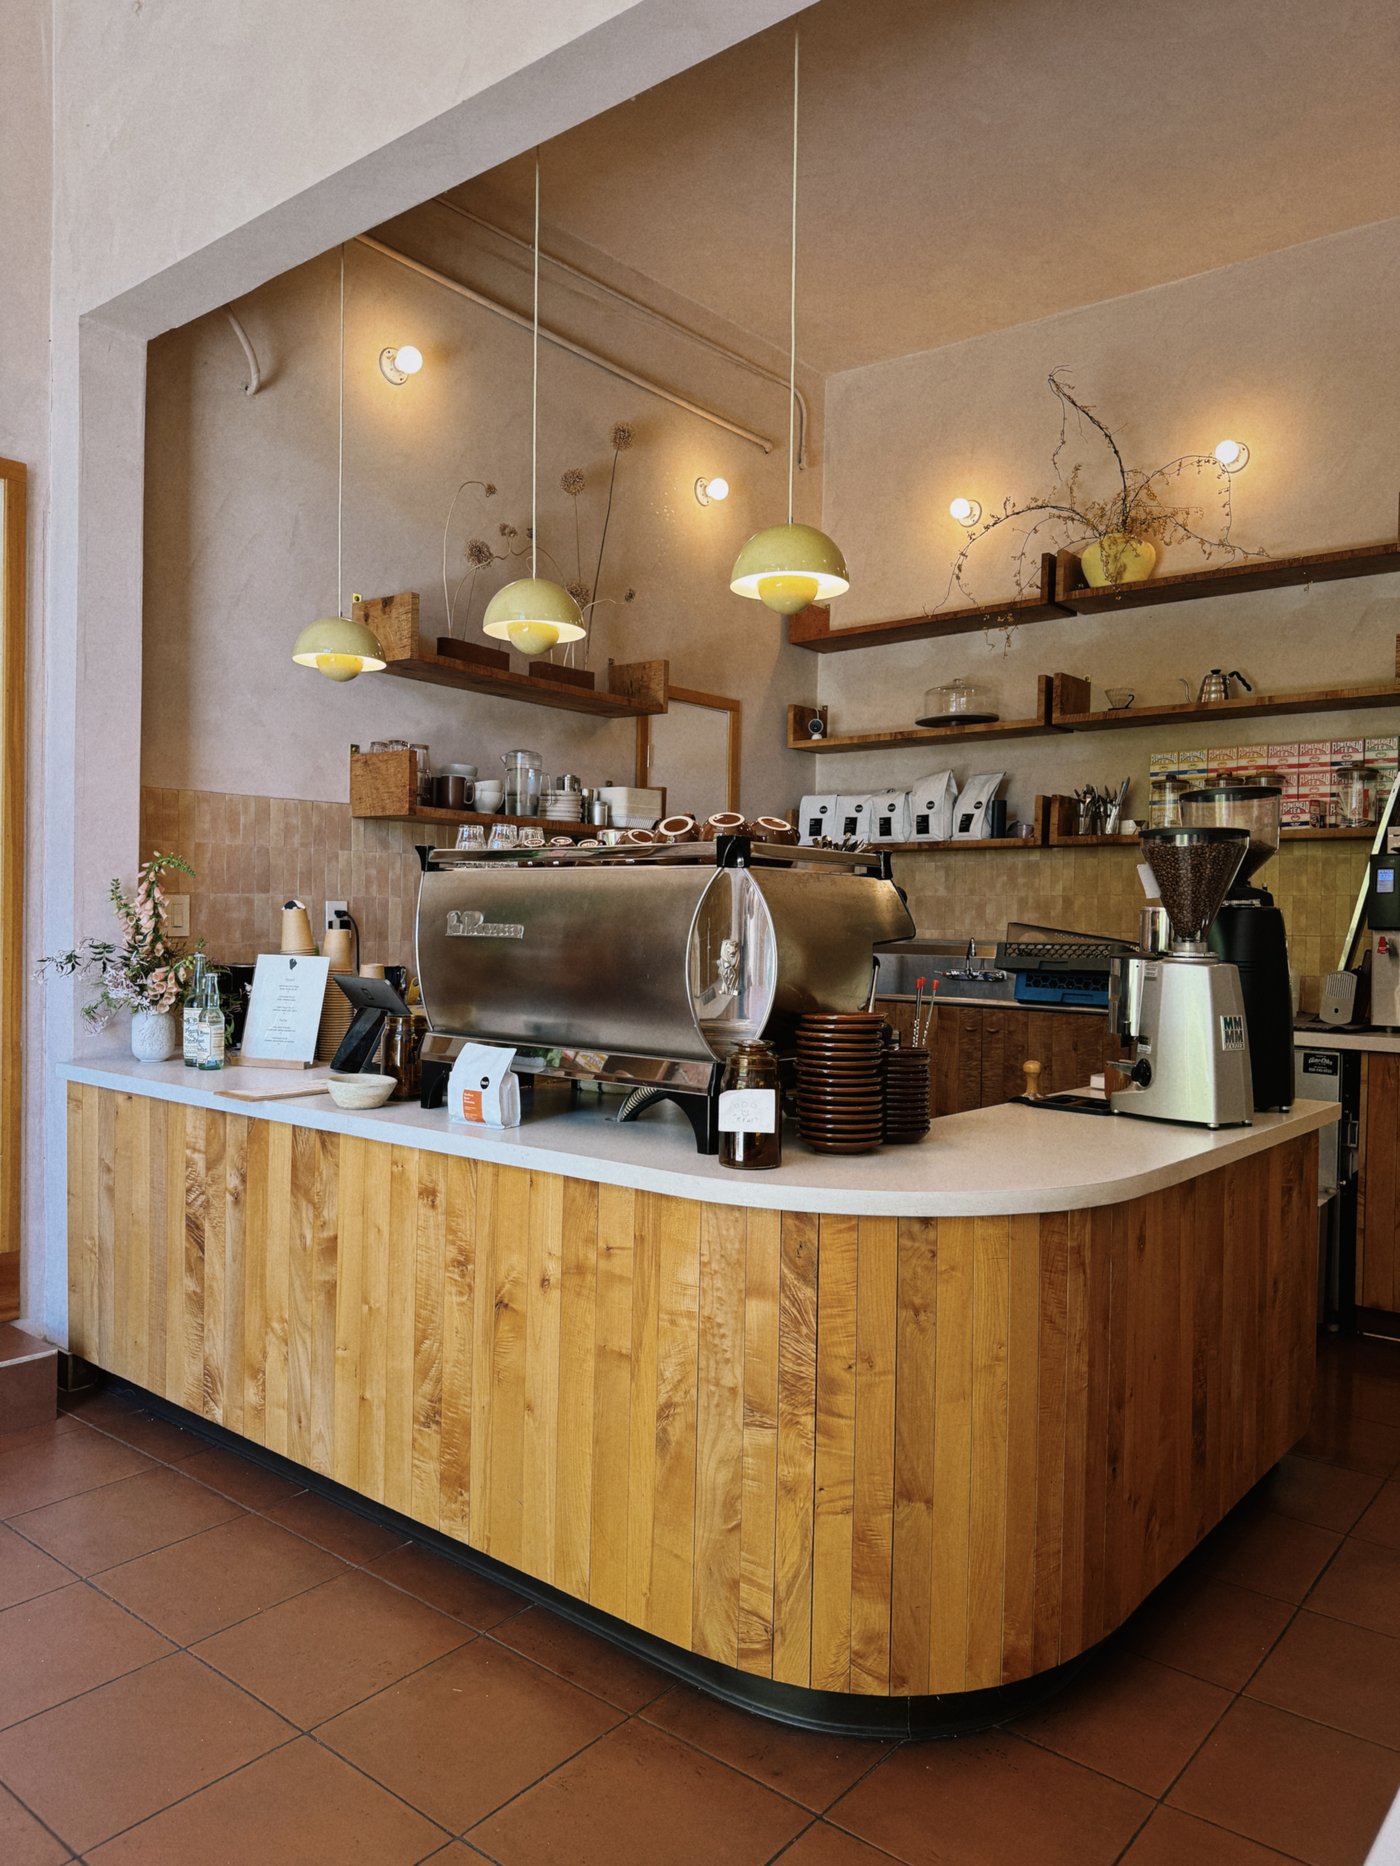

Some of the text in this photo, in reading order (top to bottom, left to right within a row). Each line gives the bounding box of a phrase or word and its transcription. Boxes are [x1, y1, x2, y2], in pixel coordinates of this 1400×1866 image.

[1269, 744, 1299, 758] FLOWERHEAD
[1299, 743, 1330, 756] FLOWERHEAD
[1332, 740, 1363, 755] FLOWERHEAD
[1365, 738, 1398, 752] FLOWERHEAD
[1299, 774, 1330, 787] FLOWERHEAD
[1282, 801, 1310, 816] FLOWERHEAD
